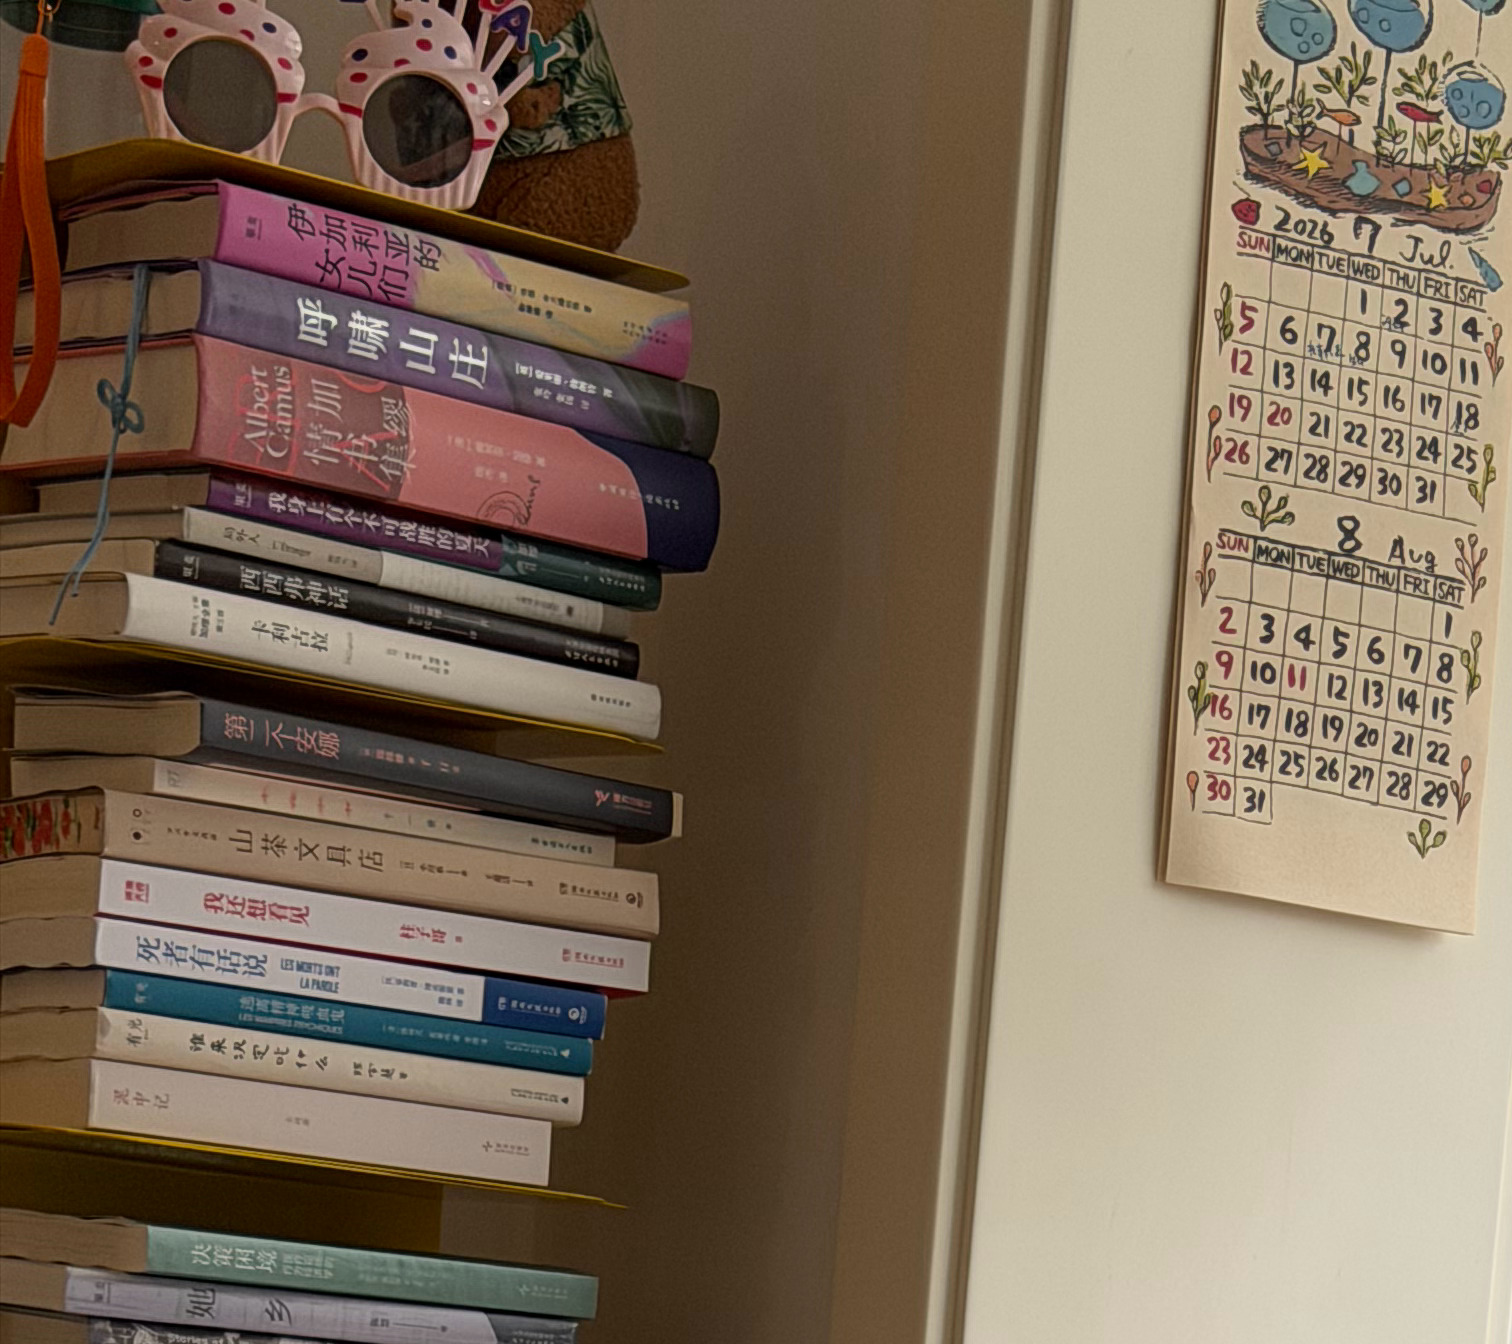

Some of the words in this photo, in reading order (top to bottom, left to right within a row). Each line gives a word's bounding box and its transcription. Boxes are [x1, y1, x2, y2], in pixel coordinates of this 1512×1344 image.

[287, 203, 442, 272] 伊加利亚的
[1274, 205, 1334, 245] 2026
[1354, 216, 1382, 254] 7
[1399, 235, 1453, 270] Jul.
[316, 248, 411, 301] 女儿们
[1237, 232, 1270, 253] SUN
[1275, 241, 1310, 264] MON
[1314, 252, 1346, 274] TUE
[1351, 260, 1380, 281] WED
[1387, 268, 1416, 289] THU
[1424, 278, 1451, 299] FRI
[1459, 285, 1486, 306] SAT
[1359, 289, 1368, 314] 1
[1394, 299, 1410, 330] 2
[1428, 308, 1443, 334] 3
[1462, 317, 1483, 342] 4
[296, 296, 490, 390] 呼啸山庄
[1239, 301, 1257, 334] 5
[1280, 316, 1297, 344] 6
[1317, 323, 1336, 354] 7
[1354, 331, 1370, 362] 8
[1391, 340, 1406, 368] 9
[1422, 350, 1447, 375] 10
[1460, 358, 1478, 386] 11
[242, 366, 270, 454] Albert
[264, 366, 293, 459] Camus
[1231, 348, 1254, 375] 12
[1273, 361, 1294, 390] 13
[1310, 369, 1333, 397] 14
[1347, 377, 1368, 406] 15
[1383, 386, 1404, 413] 16
[1421, 394, 1442, 419] 17
[1455, 402, 1479, 430] 18
[303, 423, 417, 482] 情书集
[1229, 393, 1252, 421] 19
[1267, 401, 1292, 426] 20
[1309, 413, 1330, 439] 21
[1343, 421, 1367, 447] 22
[1381, 428, 1404, 458] 23
[1416, 436, 1441, 464] 24
[1451, 447, 1478, 474] 25
[1224, 438, 1250, 464] 26
[1265, 447, 1293, 474] 27
[1303, 453, 1330, 483] 28
[1338, 461, 1366, 489] 29
[1376, 468, 1401, 496] 30
[1415, 478, 1437, 503] 31
[223, 526, 260, 545] 局外人
[268, 491, 491, 558] 我身上有个不可战胜的夏天
[1337, 516, 1362, 552] 8
[1388, 536, 1438, 572] Aug
[240, 565, 349, 610] 西西弗神话
[1216, 532, 1249, 552] SUN
[1256, 542, 1291, 563] MON
[1296, 552, 1326, 572] TUE
[1331, 558, 1361, 579] WED
[1368, 566, 1396, 586] THU
[1404, 574, 1431, 596] FRI
[1438, 582, 1466, 603] SAT
[251, 620, 329, 653] 卡利古拉
[1218, 606, 1237, 634] 2
[1260, 613, 1275, 643] 3
[1294, 624, 1315, 651] 4
[1332, 626, 1349, 658] 5
[1367, 636, 1384, 664] 6
[1404, 644, 1422, 672] 7
[1436, 654, 1453, 683] 8
[1444, 611, 1452, 638] 1
[1216, 651, 1233, 679] 9
[1251, 661, 1276, 684] 10
[1288, 664, 1306, 690] 11
[1328, 672, 1348, 701] 12
[1362, 679, 1383, 708] 13
[1398, 688, 1419, 715] 14
[1432, 696, 1453, 724] 15
[224, 712, 341, 760] 第二个安娜
[1206, 775, 1231, 801] 30
[1244, 788, 1266, 812] 31
[228, 828, 383, 873] 山茶文具店
[203, 892, 311, 927] 我还想看见
[136, 936, 268, 977] 死者有话说
[281, 958, 295, 971] LES
[300, 977, 309, 989] LA
[126, 1018, 143, 1048] 有光
[189, 1033, 330, 1071] 谁来决定吃什么
[113, 1088, 170, 1110] 泥中记
[192, 1243, 277, 1274] 决策困境
[186, 1286, 292, 1327] 她乡
